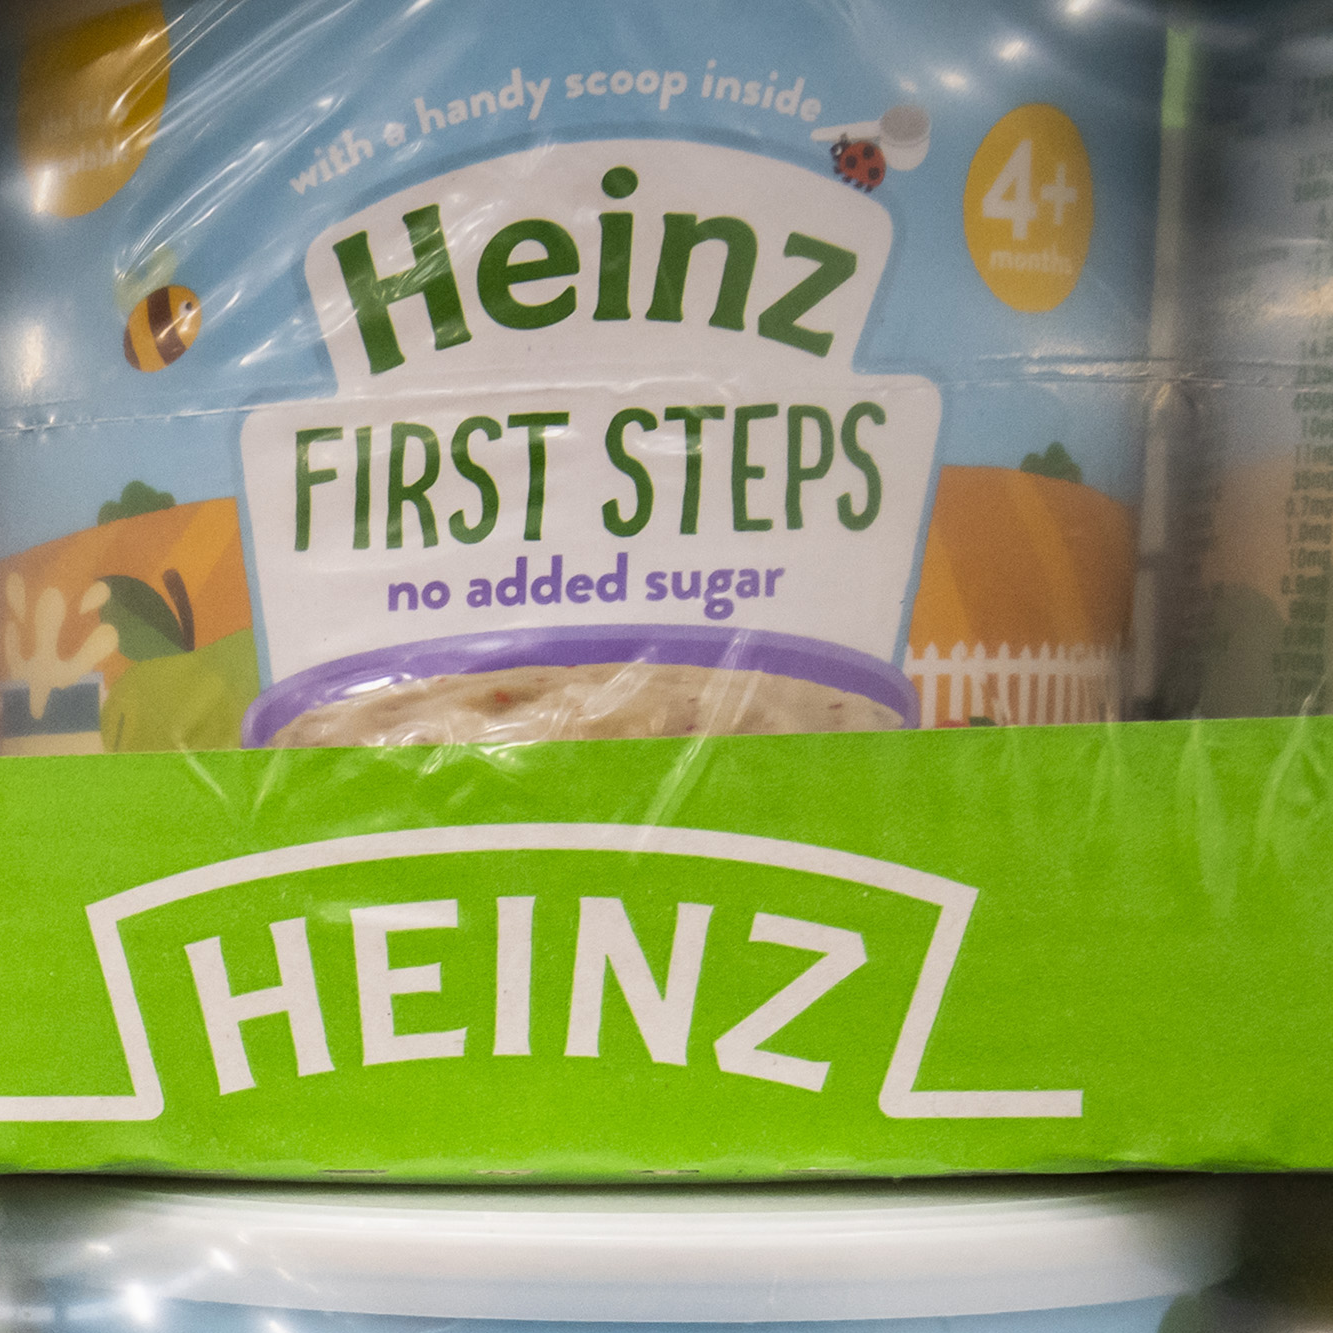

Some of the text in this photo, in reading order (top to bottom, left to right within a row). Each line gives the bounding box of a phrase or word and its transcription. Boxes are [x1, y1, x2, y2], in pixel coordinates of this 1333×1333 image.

[289, 60, 822, 196] with a handy scoop inside
[982, 138, 1078, 241] 4+
[333, 166, 857, 376] Heinz
[292, 402, 887, 552] FIRST STEPS
[387, 552, 786, 620] no added sugar
[184, 896, 869, 1096] HEINZ
